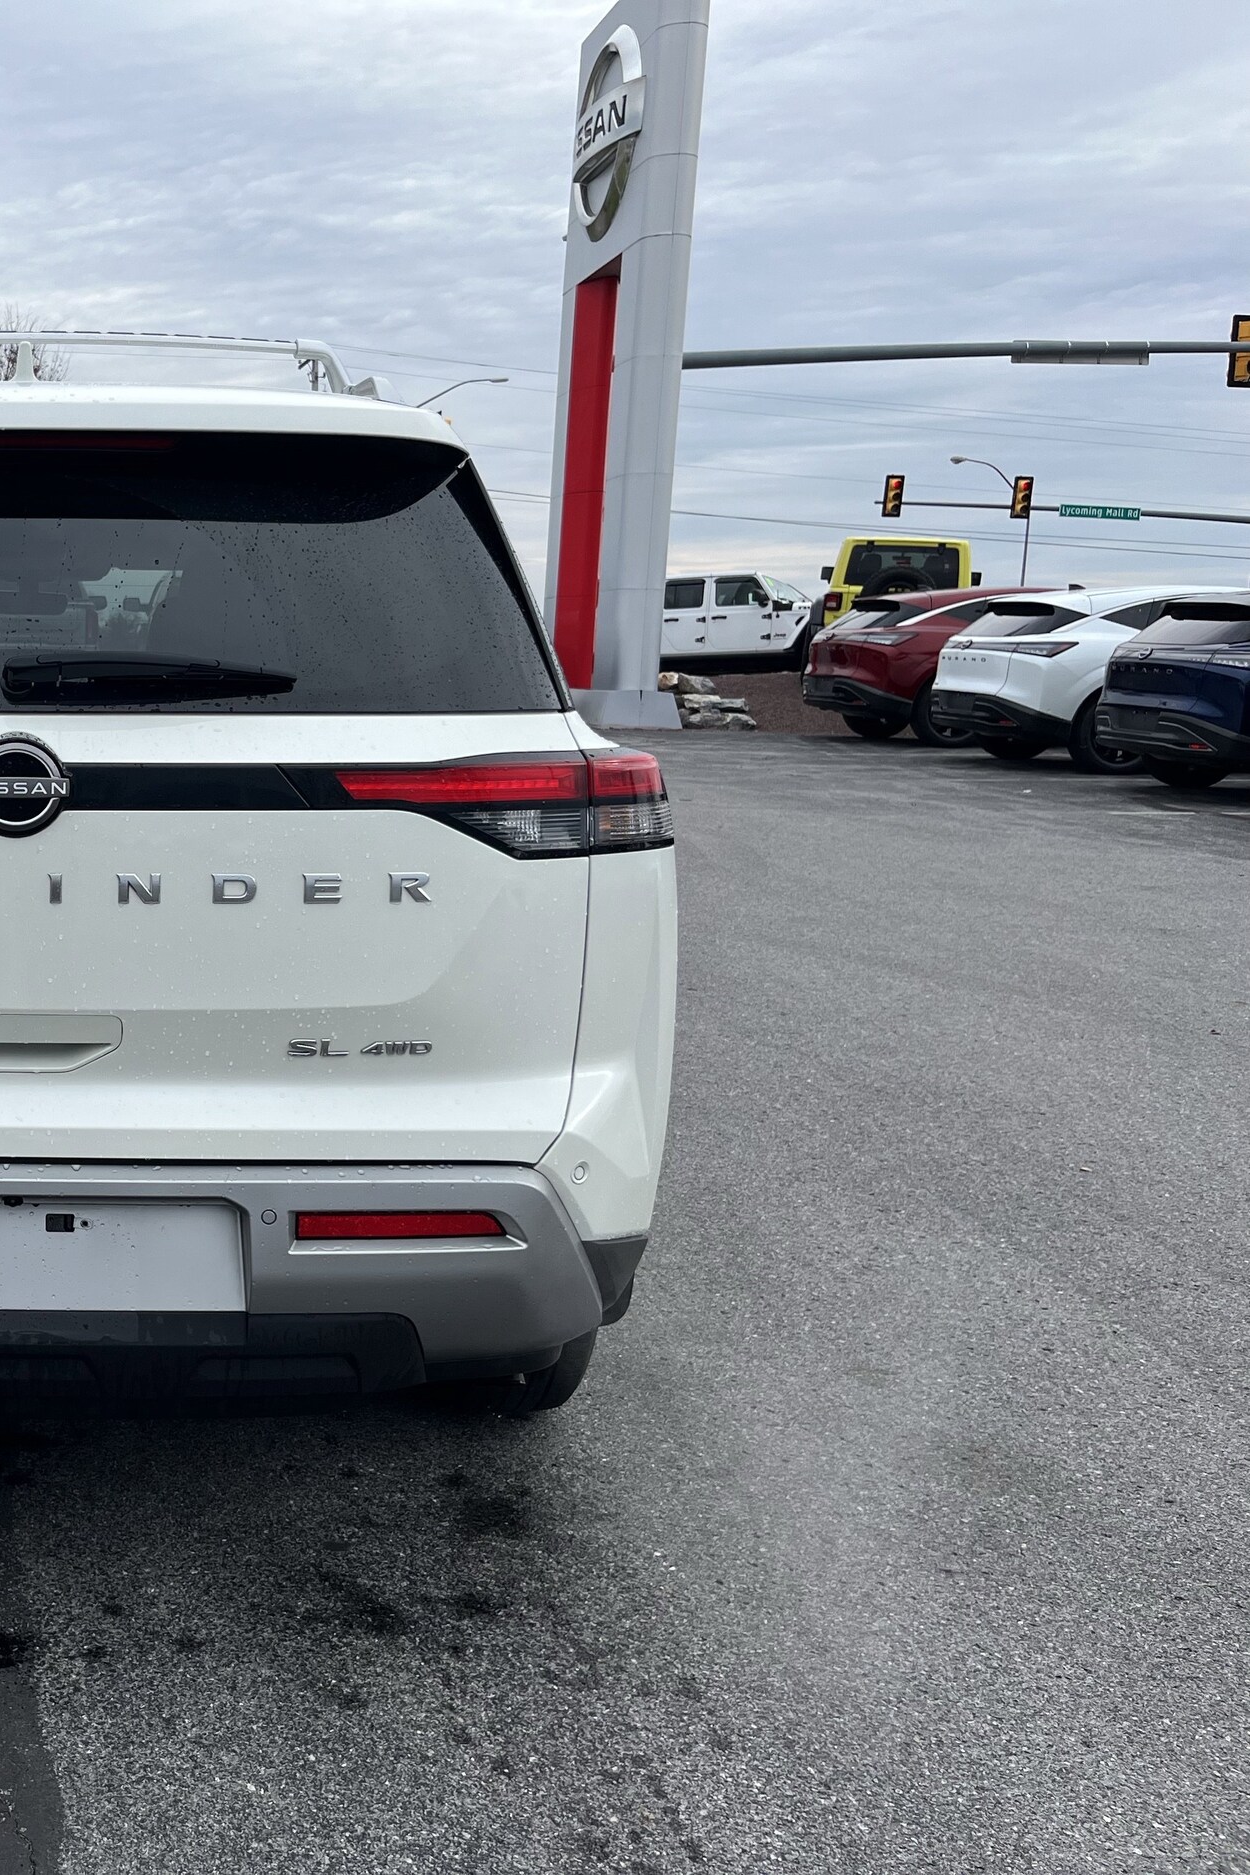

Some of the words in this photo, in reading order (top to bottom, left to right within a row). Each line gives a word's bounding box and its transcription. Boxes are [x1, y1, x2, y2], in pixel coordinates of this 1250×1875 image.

[575, 94, 627, 159] SSAN
[1061, 505, 1103, 518] Lycoming
[1105, 507, 1124, 518] Mall
[1127, 508, 1139, 518] Rd
[286, 1038, 350, 1057] SL
[360, 1040, 433, 1056] 4WD
